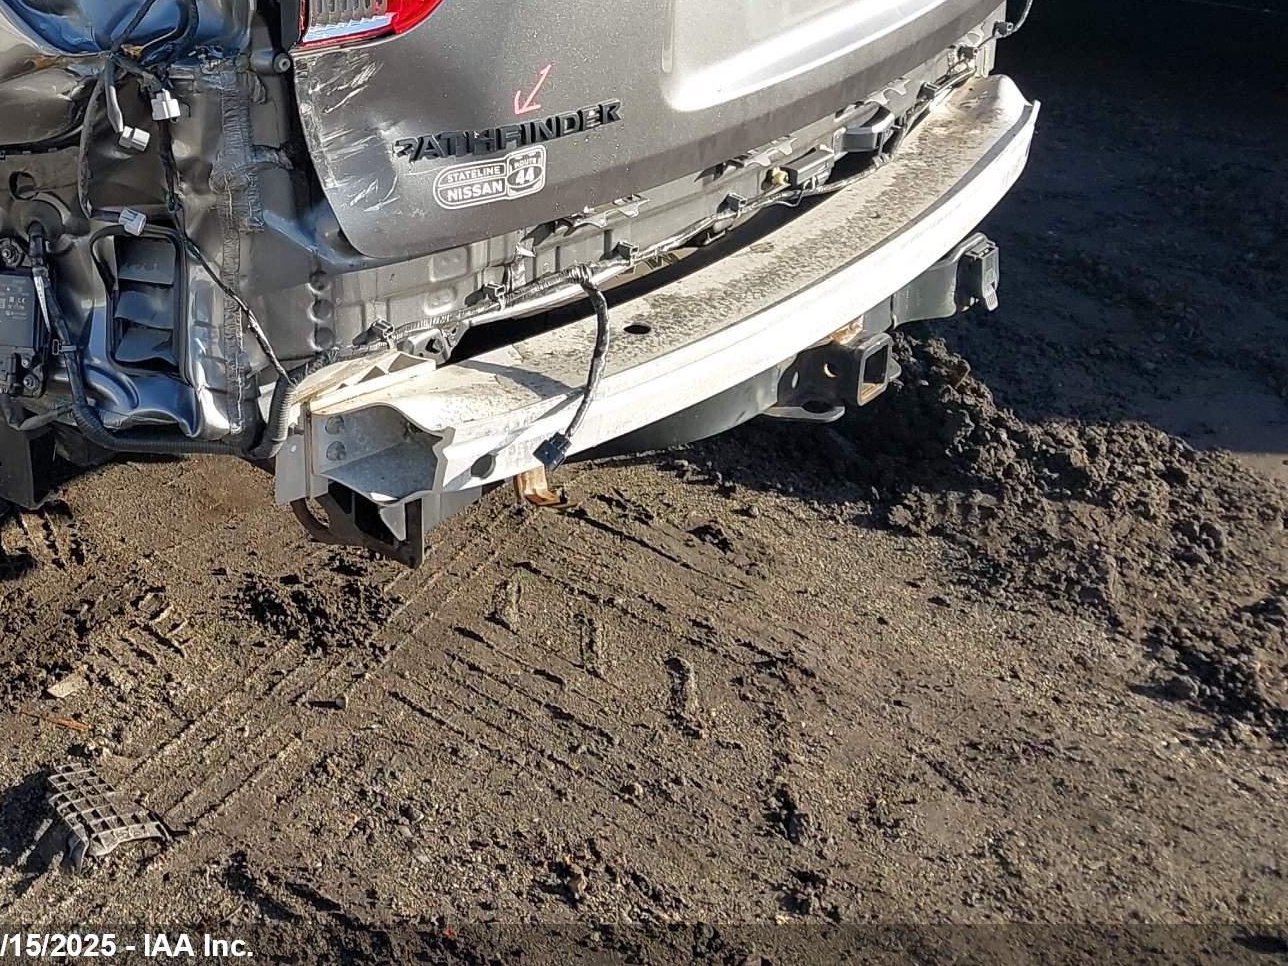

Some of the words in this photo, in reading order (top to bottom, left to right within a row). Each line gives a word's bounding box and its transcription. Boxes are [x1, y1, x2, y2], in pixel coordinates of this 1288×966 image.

[393, 99, 621, 163] PATHFINDER
[514, 157, 538, 169] ROUTE
[447, 166, 502, 183] STATELINE
[515, 167, 535, 185] 44
[447, 180, 503, 202] NISSAN
